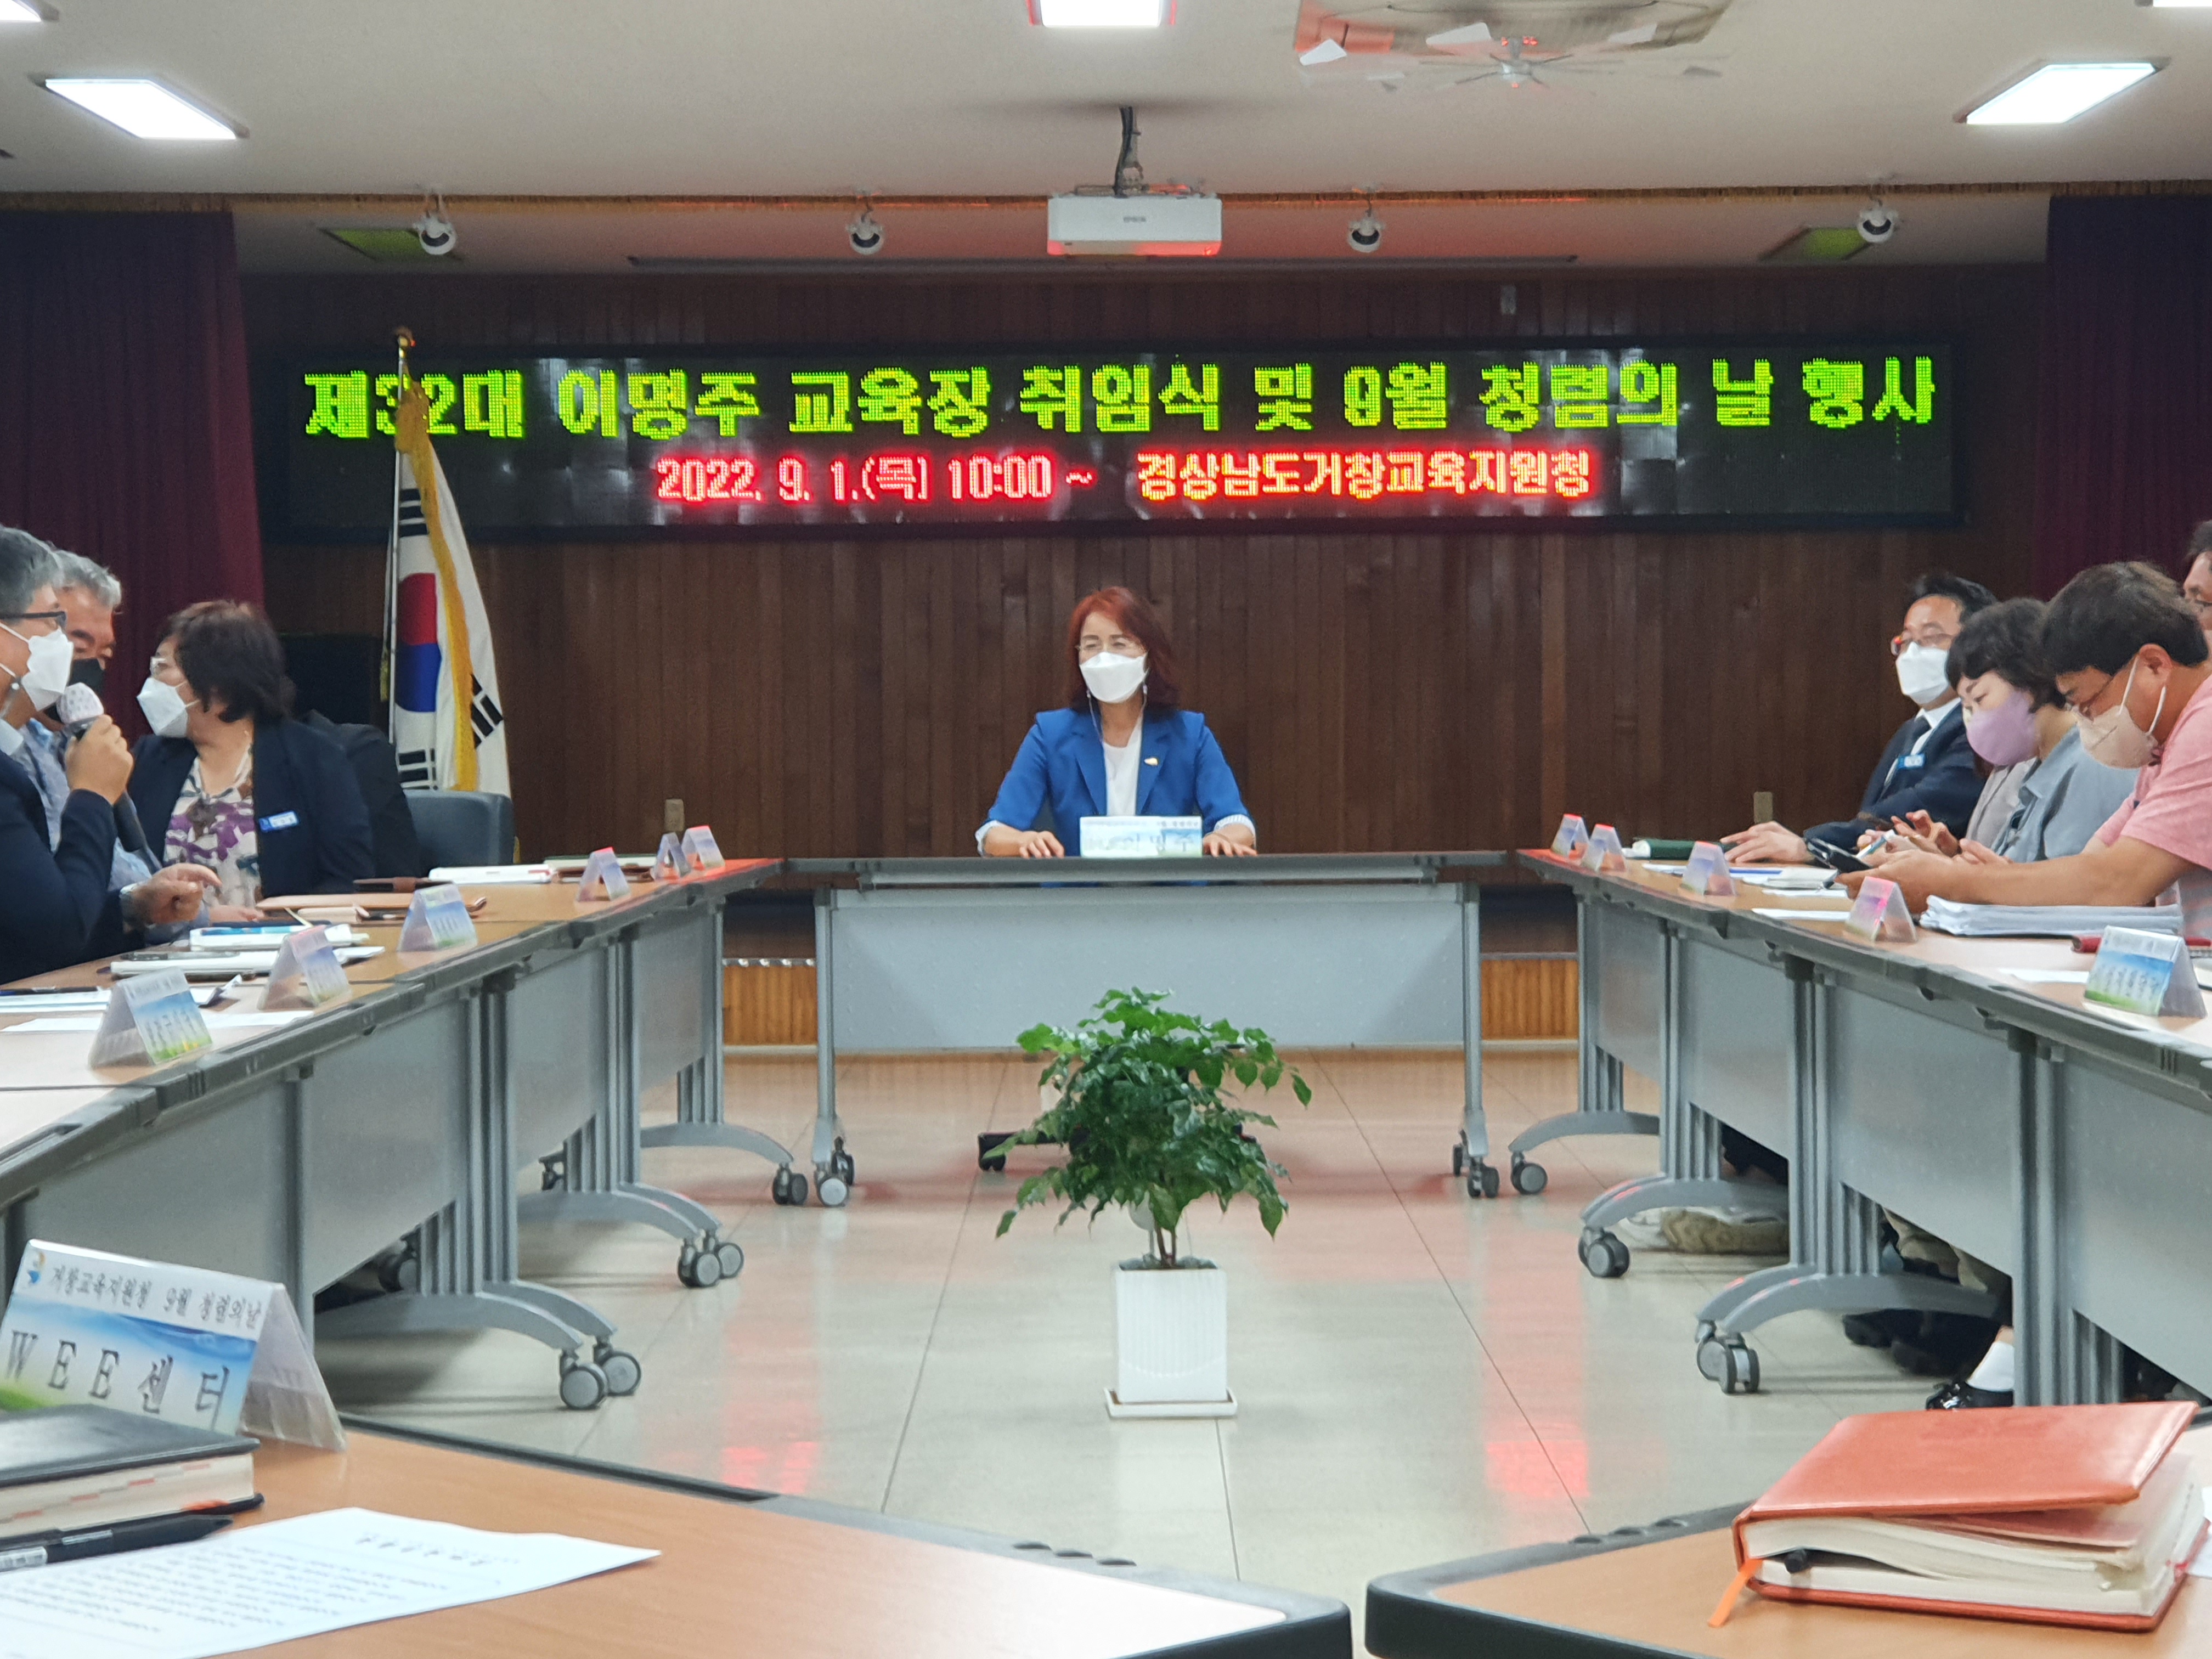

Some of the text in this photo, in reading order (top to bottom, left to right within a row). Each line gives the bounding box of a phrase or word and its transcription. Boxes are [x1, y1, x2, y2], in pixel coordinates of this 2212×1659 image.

[305, 357, 1936, 441] 제32대 이명주 교육장 취임식 및 9월 청렴의 날 행사
[657, 458, 762, 502] 2022.
[778, 458, 810, 502] 9.
[949, 454, 1052, 500] 10:00
[1137, 450, 1590, 500] 경상남도거창교육지원청
